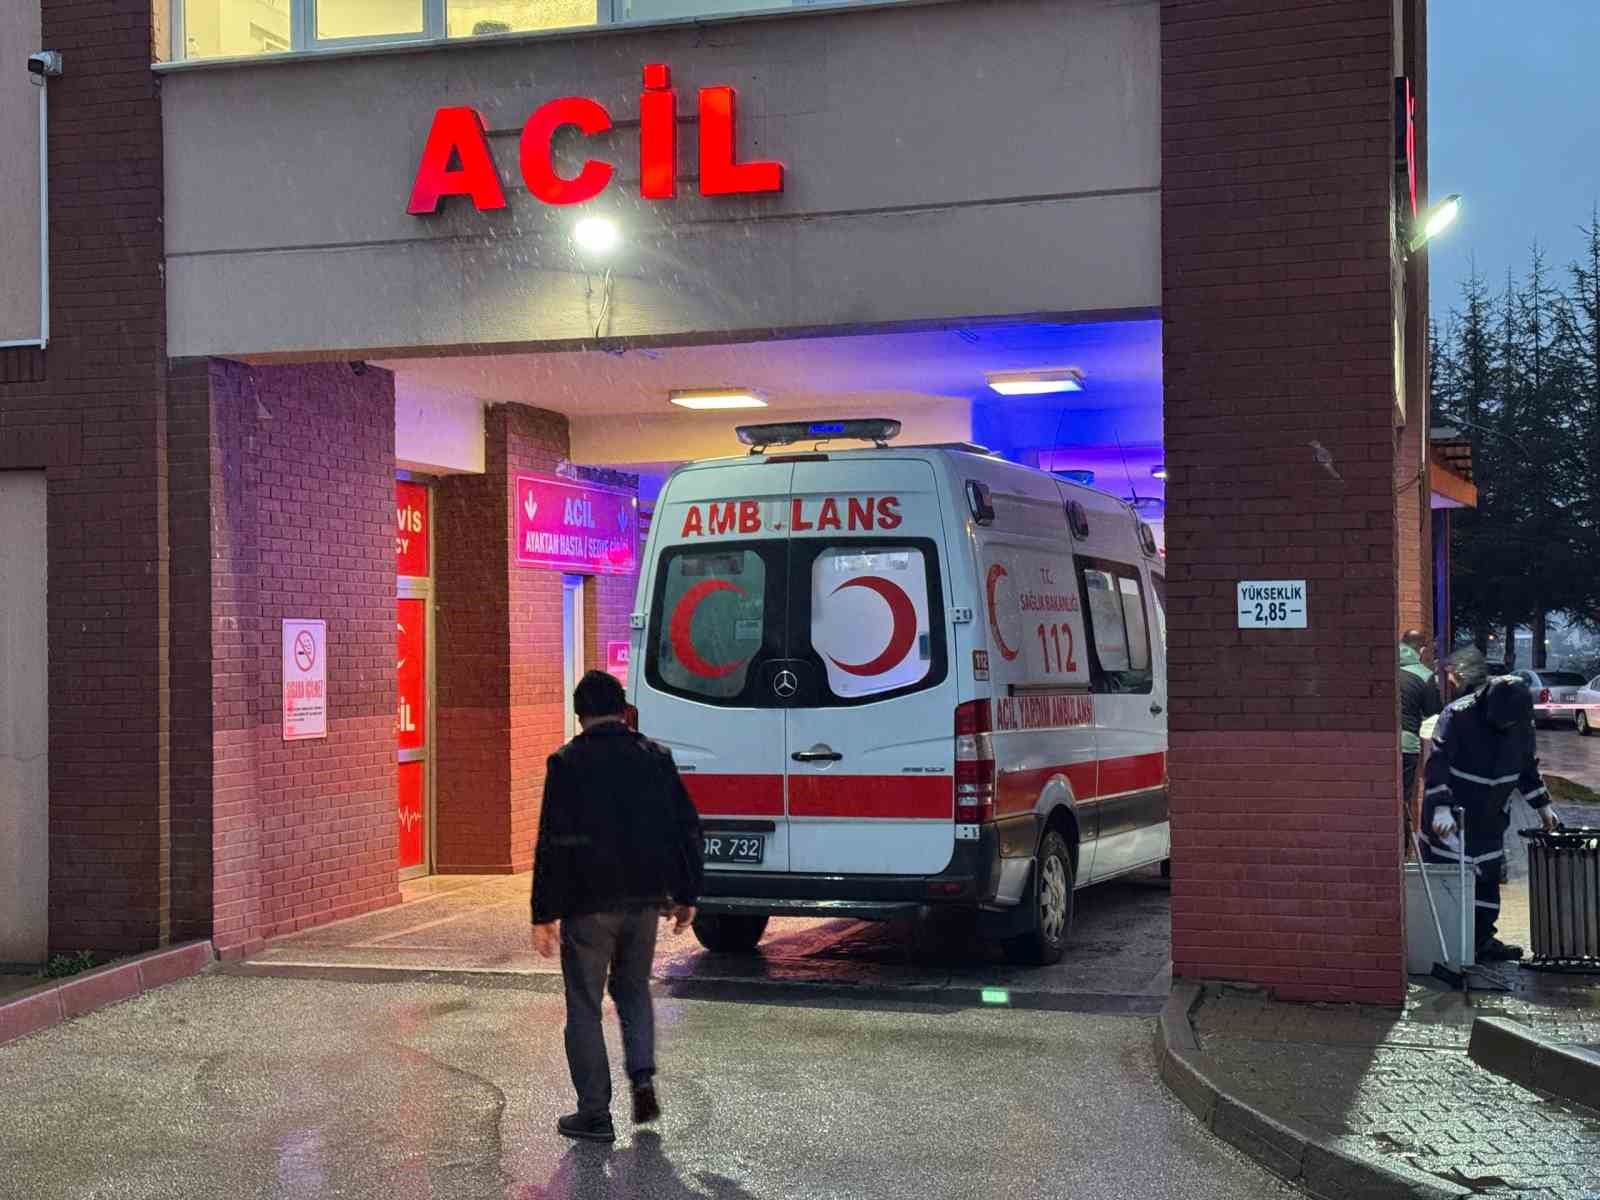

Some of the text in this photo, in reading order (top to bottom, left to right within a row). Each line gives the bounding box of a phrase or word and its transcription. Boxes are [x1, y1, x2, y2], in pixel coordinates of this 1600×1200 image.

[406, 64, 784, 216] ACİL
[563, 493, 596, 529] ACİL
[1241, 584, 1302, 601] YÜKSEKLİK
[1038, 623, 1077, 673] 112
[728, 839, 759, 856] 732
